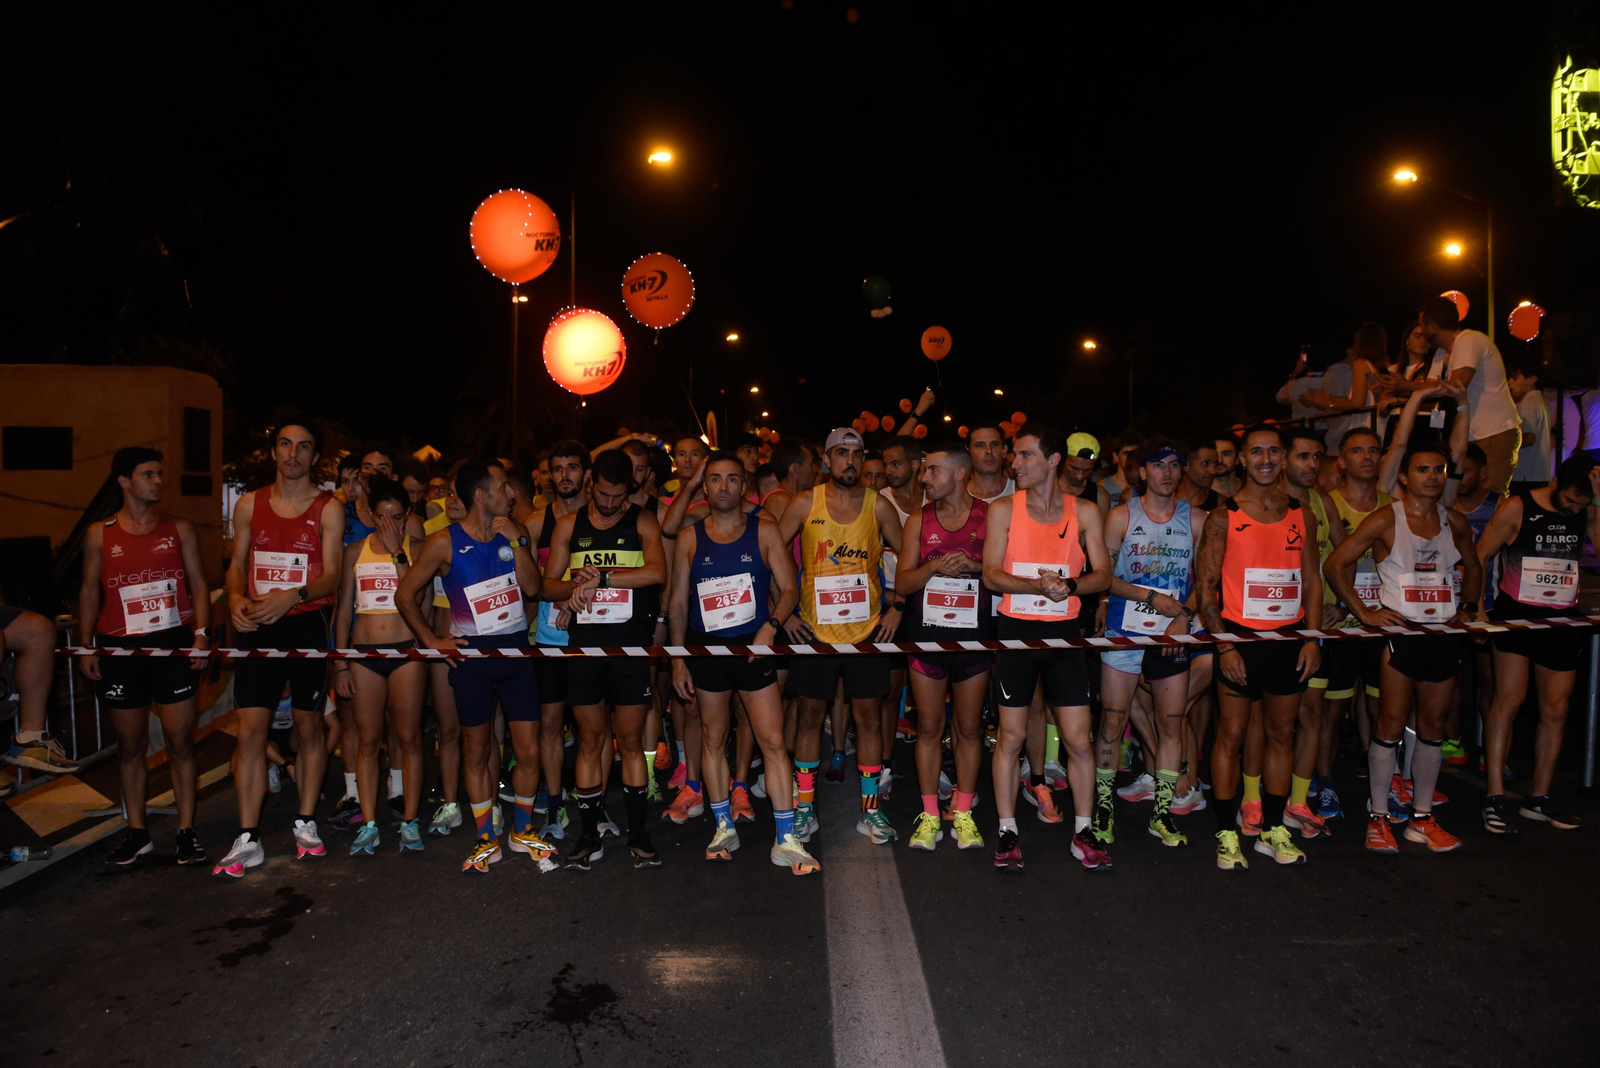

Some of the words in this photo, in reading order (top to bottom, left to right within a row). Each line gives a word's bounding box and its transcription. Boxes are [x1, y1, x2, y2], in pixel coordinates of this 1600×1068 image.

[646, 294, 668, 302] SEVILLA
[574, 359, 607, 367] NOCTURNA
[1535, 534, 1543, 543] O
[1546, 534, 1578, 543] BARCO
[833, 542, 868, 559] Álora
[1127, 541, 1190, 558] Atletismo
[583, 553, 617, 566] ASM
[1130, 560, 1187, 577] Bollullos
[267, 570, 289, 581] 124
[1536, 573, 1564, 585] 9621
[375, 579, 389, 589] 62
[832, 592, 852, 603] 241
[1267, 587, 1283, 598] 26
[1418, 591, 1438, 601] 171
[142, 598, 166, 612] 204
[488, 594, 509, 609] 240
[716, 594, 738, 607] 265
[944, 595, 958, 606] 37
